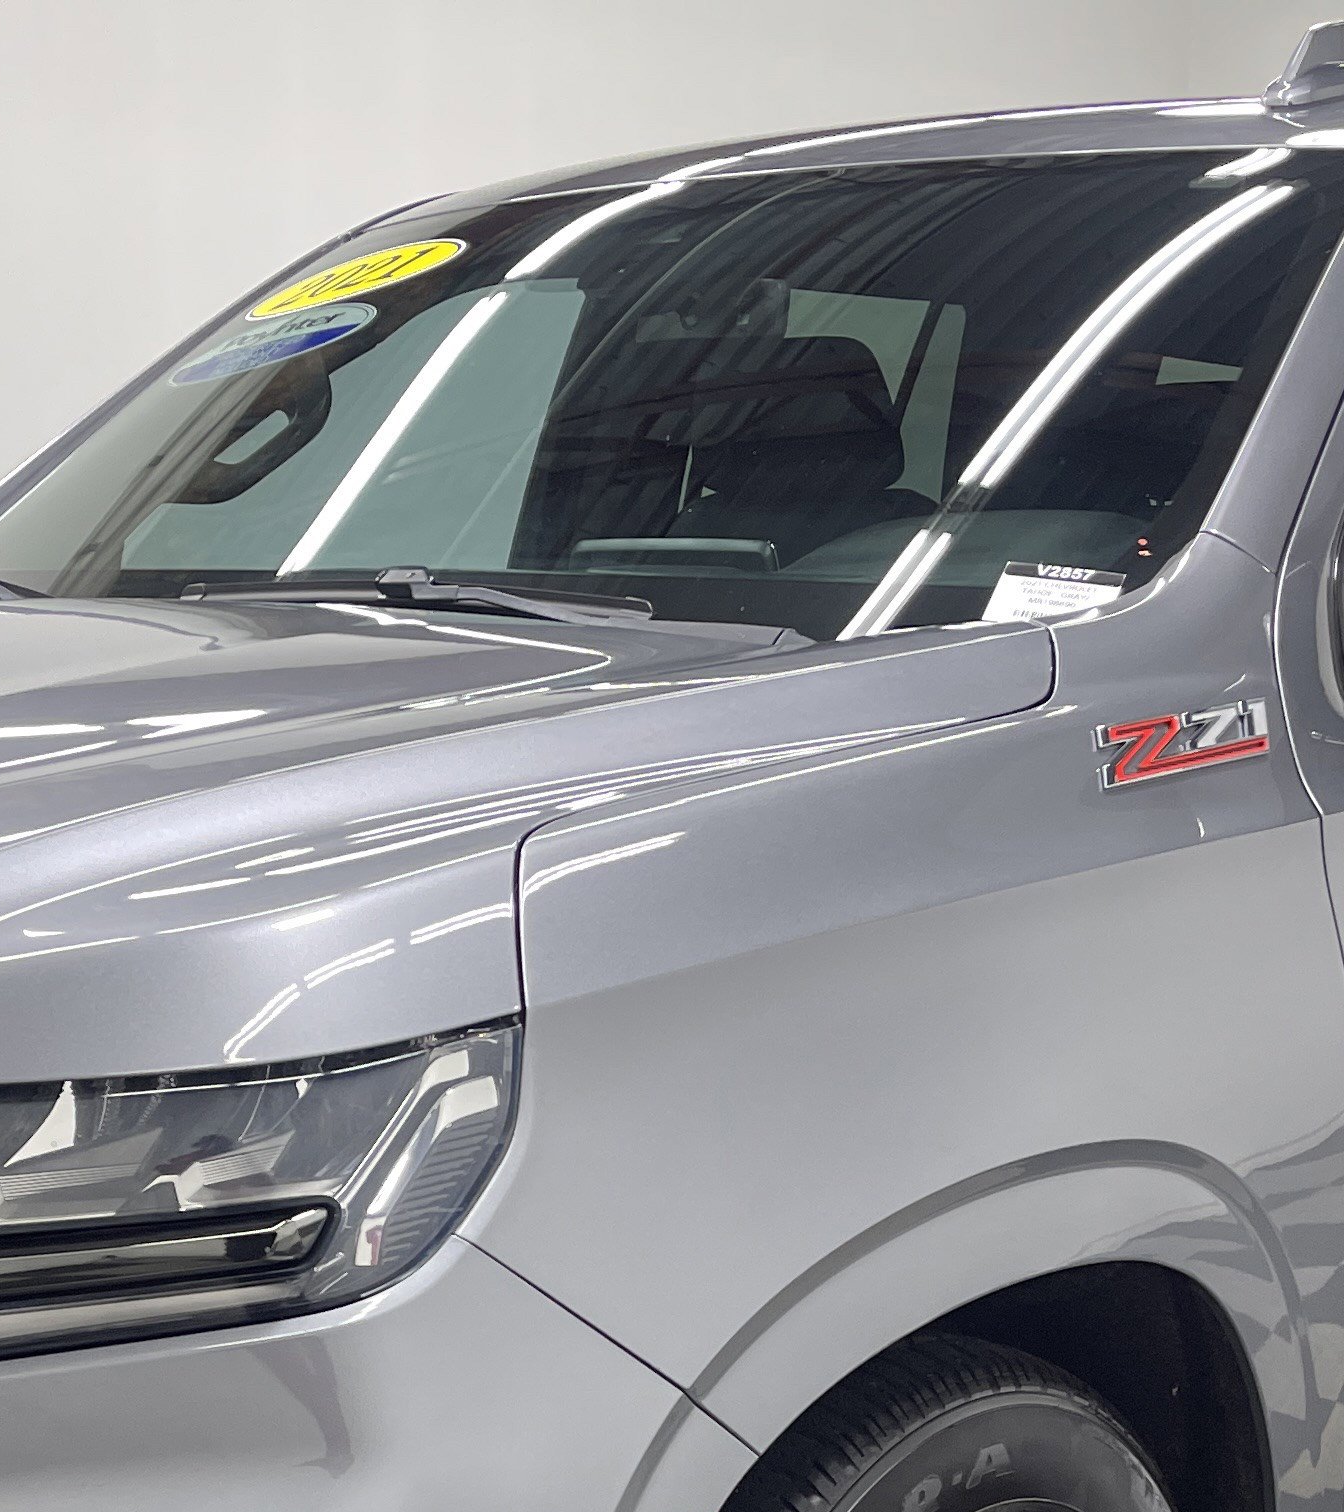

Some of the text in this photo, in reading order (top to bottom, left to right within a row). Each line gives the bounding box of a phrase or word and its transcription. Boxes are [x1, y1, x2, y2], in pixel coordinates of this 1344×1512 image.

[268, 245, 440, 311] 2021
[1037, 563, 1096, 581] V2857
[1092, 698, 1270, 790] Z71
